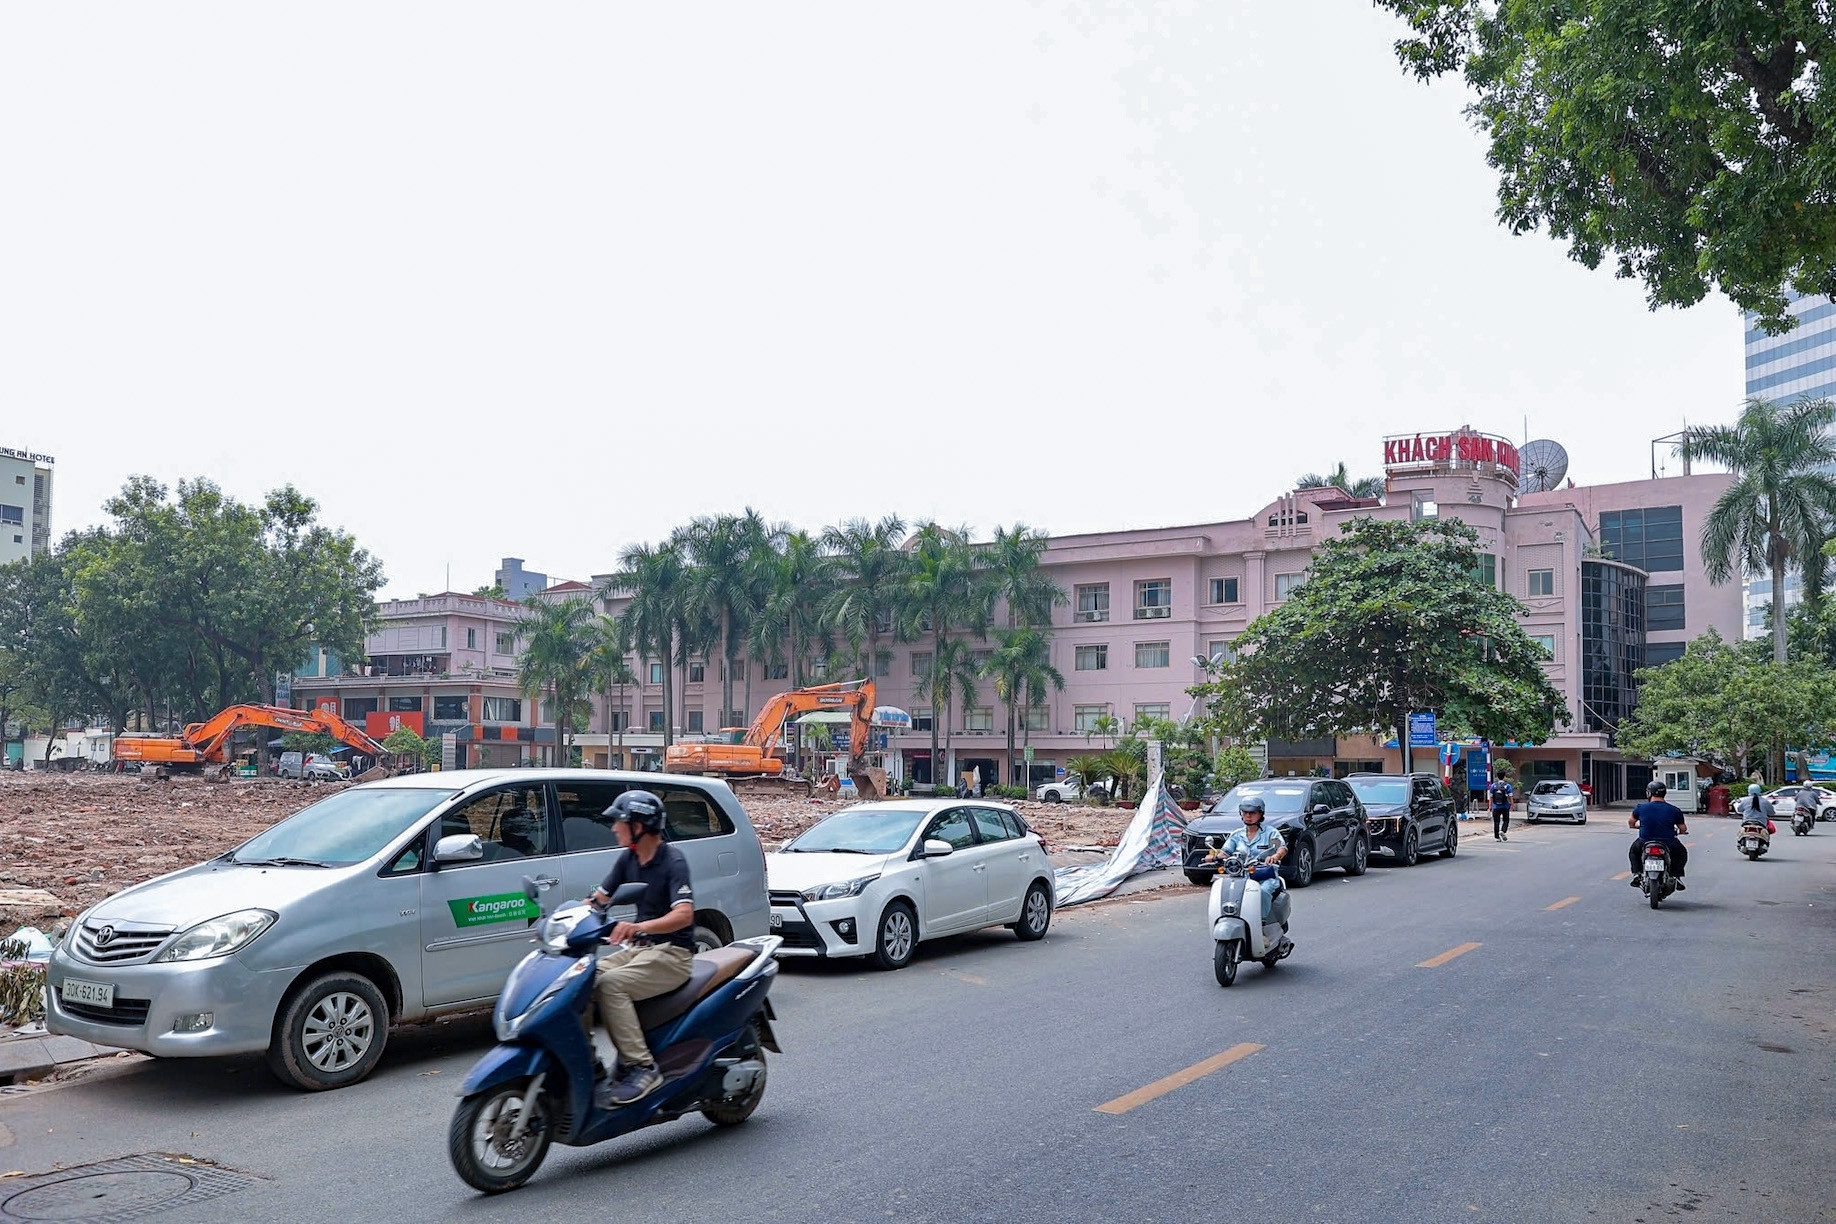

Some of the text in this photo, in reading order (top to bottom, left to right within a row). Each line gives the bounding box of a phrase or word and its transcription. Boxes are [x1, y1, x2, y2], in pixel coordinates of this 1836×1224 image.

[1384, 433, 1451, 464] KHÁCH
[1458, 436, 1493, 464] SẠN
[29, 452, 55, 464] HOTEL
[467, 898, 526, 914] Kangaroo
